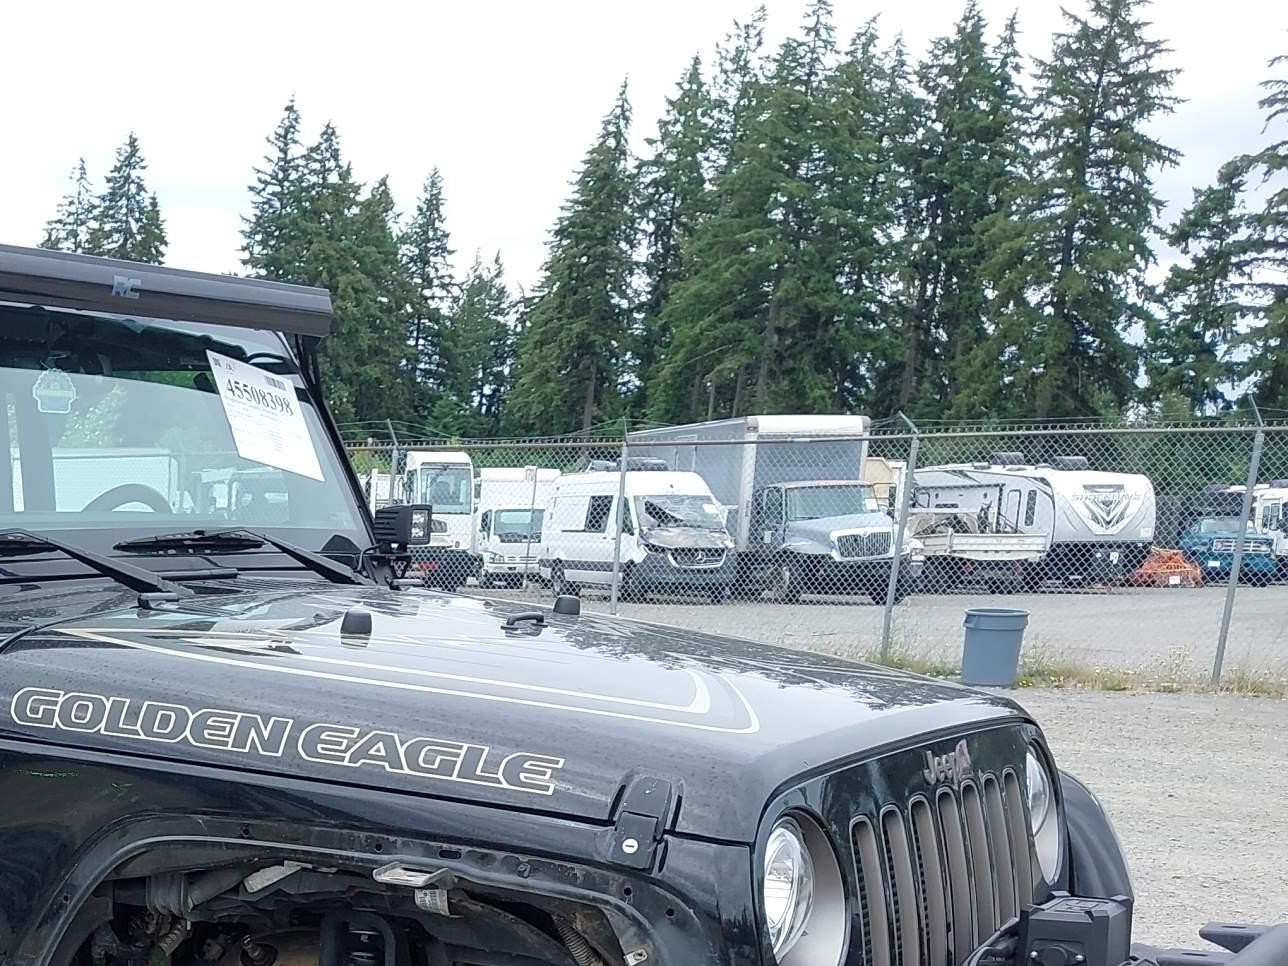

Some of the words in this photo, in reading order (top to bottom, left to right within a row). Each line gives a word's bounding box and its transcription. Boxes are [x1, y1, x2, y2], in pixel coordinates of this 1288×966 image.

[226, 378, 294, 416] 45508398
[11, 686, 294, 757] GOLDEN
[298, 722, 566, 795] EAGLE
[923, 750, 959, 790] Jeep
